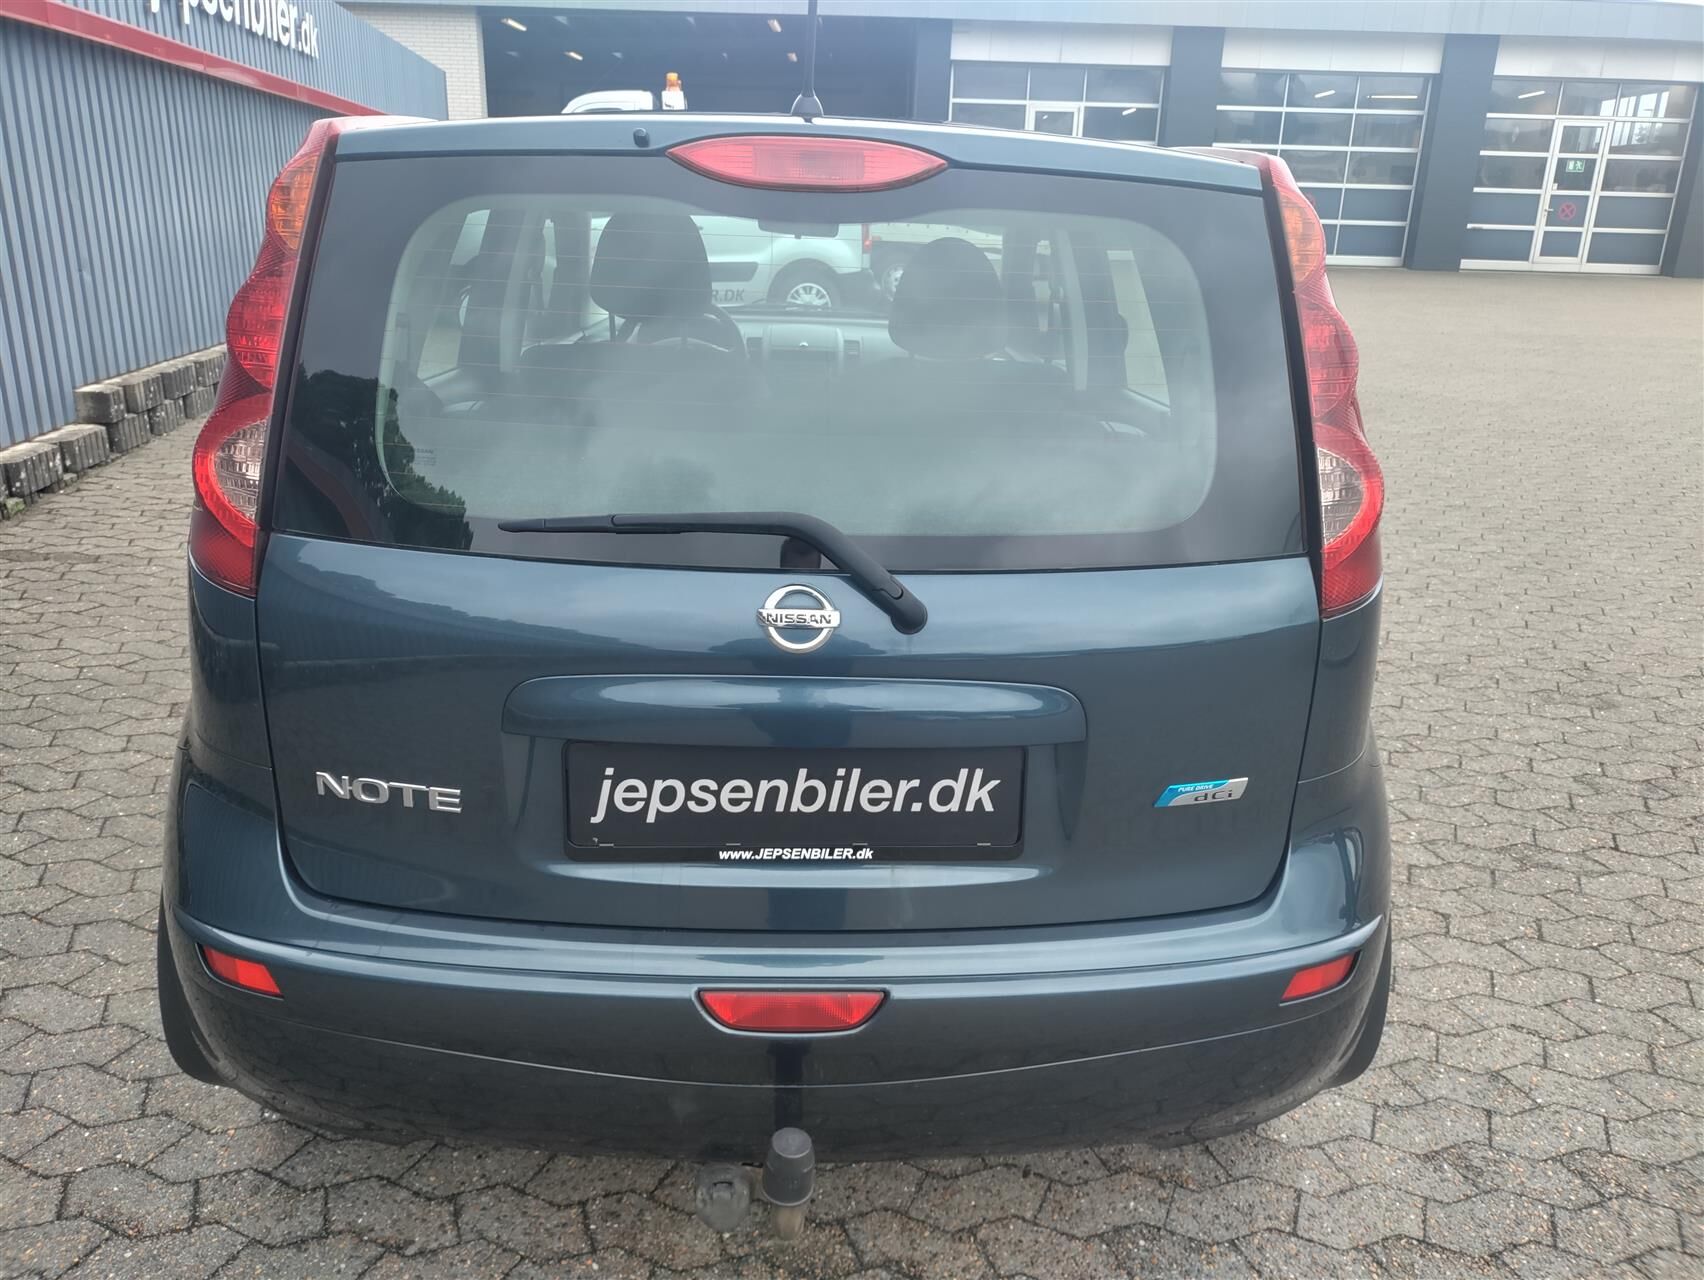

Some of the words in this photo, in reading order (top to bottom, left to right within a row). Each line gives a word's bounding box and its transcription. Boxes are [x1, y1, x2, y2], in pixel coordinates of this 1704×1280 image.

[766, 612, 832, 625] NISSAN
[315, 771, 463, 813] NOTE
[1178, 785, 1194, 793] PURE
[1195, 783, 1215, 791] DRIVE
[590, 767, 1000, 823] jepsenbiler.dk
[1193, 789, 1233, 802] dCi
[719, 848, 874, 860] www.JEPSENBILER.dk
